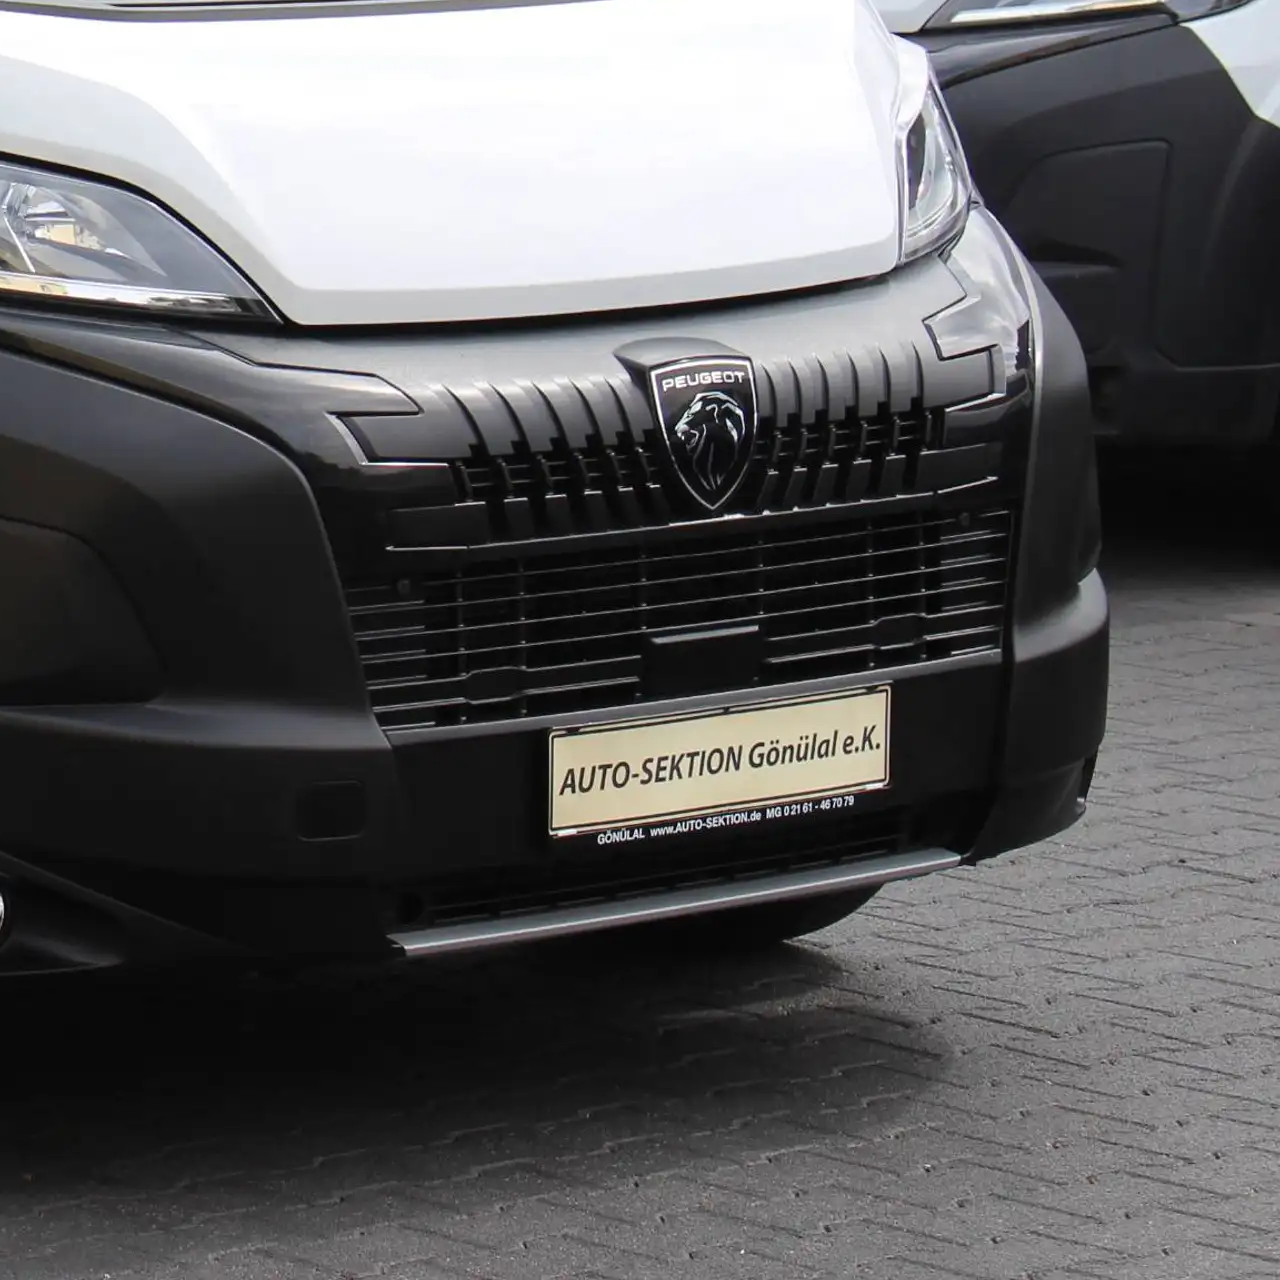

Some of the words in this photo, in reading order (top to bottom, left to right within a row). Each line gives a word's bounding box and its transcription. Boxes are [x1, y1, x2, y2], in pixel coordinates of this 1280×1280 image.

[662, 371, 744, 391] PEUGEOT
[559, 746, 742, 795] AUTO-SEKTION
[748, 730, 838, 768] Gönülal
[843, 725, 881, 755] e.K.
[597, 828, 644, 844] GÖNÜLAL
[650, 811, 761, 837] www.AUTO-SEKTION.de
[766, 807, 782, 819] MG
[783, 805, 790, 816] 0
[791, 805, 801, 815] 21
[803, 802, 813, 814] 61
[820, 799, 831, 810] 46
[832, 797, 843, 808] 70
[844, 795, 855, 806] 79
